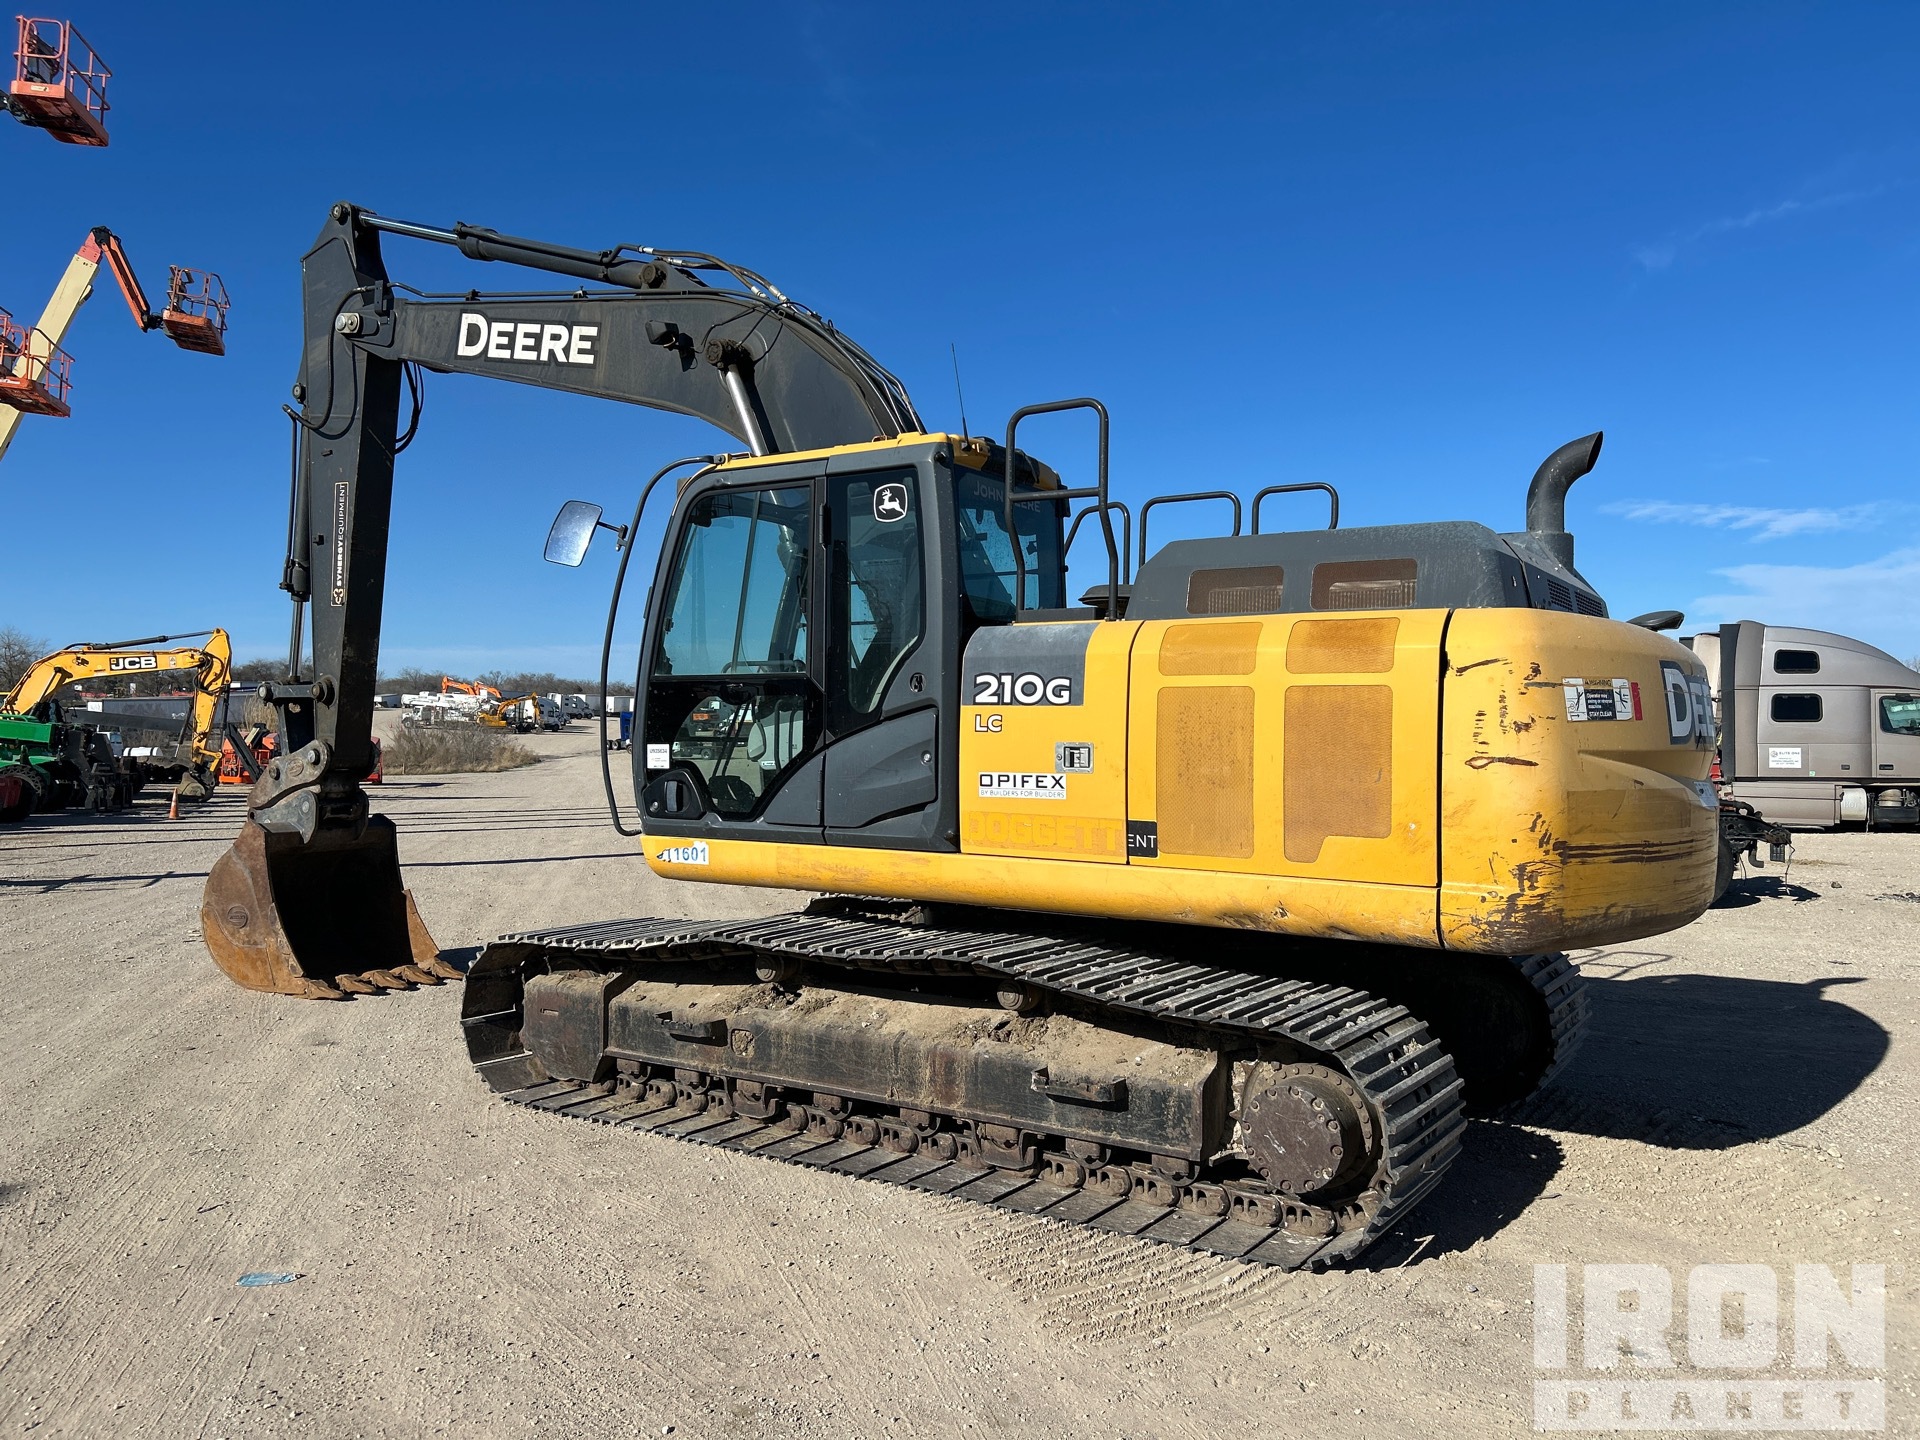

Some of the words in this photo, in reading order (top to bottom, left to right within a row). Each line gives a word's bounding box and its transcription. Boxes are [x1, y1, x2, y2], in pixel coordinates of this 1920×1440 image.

[457, 313, 598, 364] DEERE
[974, 481, 1004, 502] JOHN
[111, 656, 157, 670] JCB
[973, 672, 1072, 705] 210G
[975, 714, 1002, 732] LC
[980, 774, 1065, 789] OPIFEX
[657, 847, 706, 862] 11601
